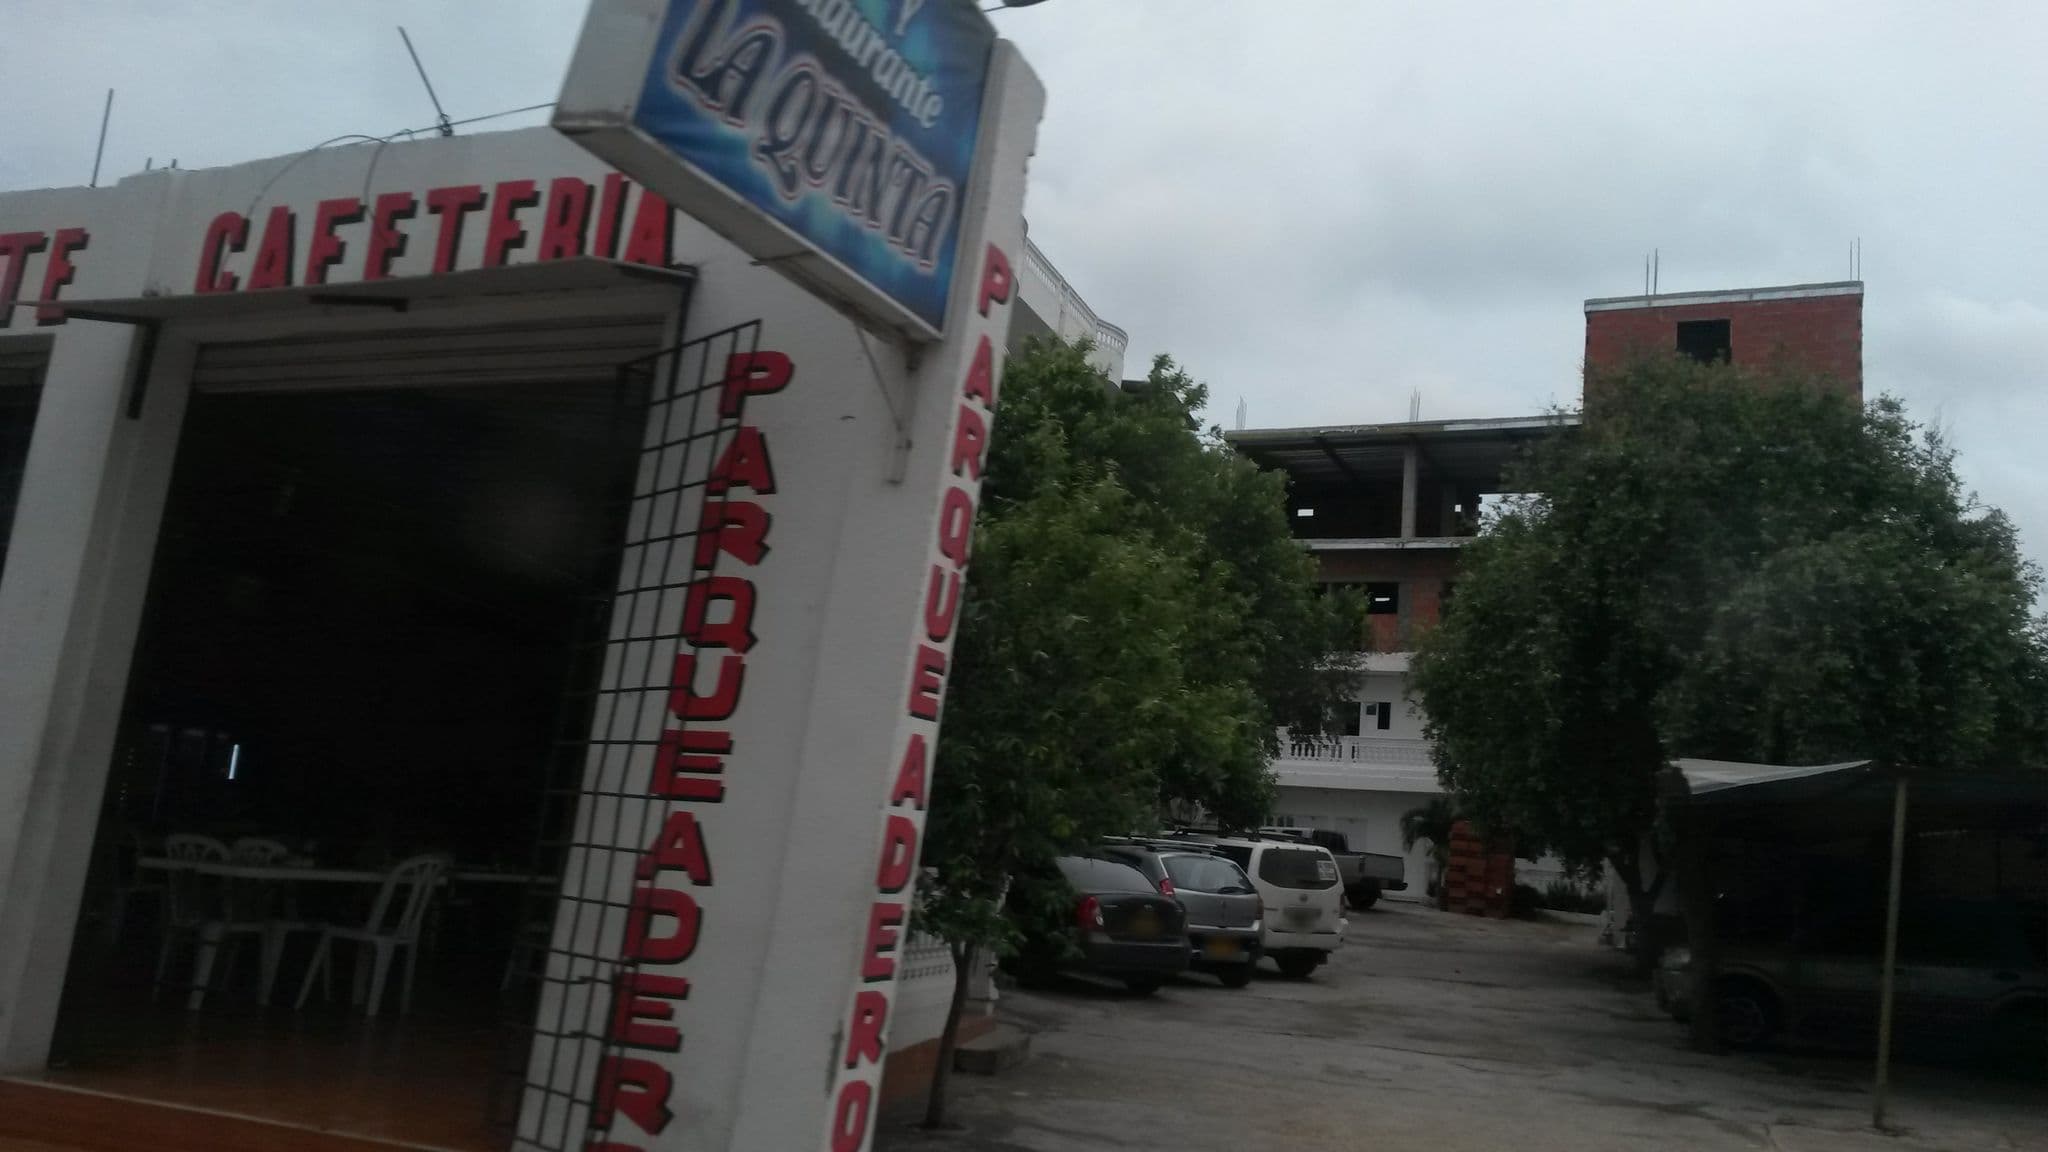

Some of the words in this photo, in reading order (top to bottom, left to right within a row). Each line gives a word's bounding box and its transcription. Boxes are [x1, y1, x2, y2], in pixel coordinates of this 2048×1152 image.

[193, 172, 676, 294] CAFETERIA
[583, 350, 796, 1152] PARQUEADER
[830, 242, 1017, 1152] PARQUEADERO
